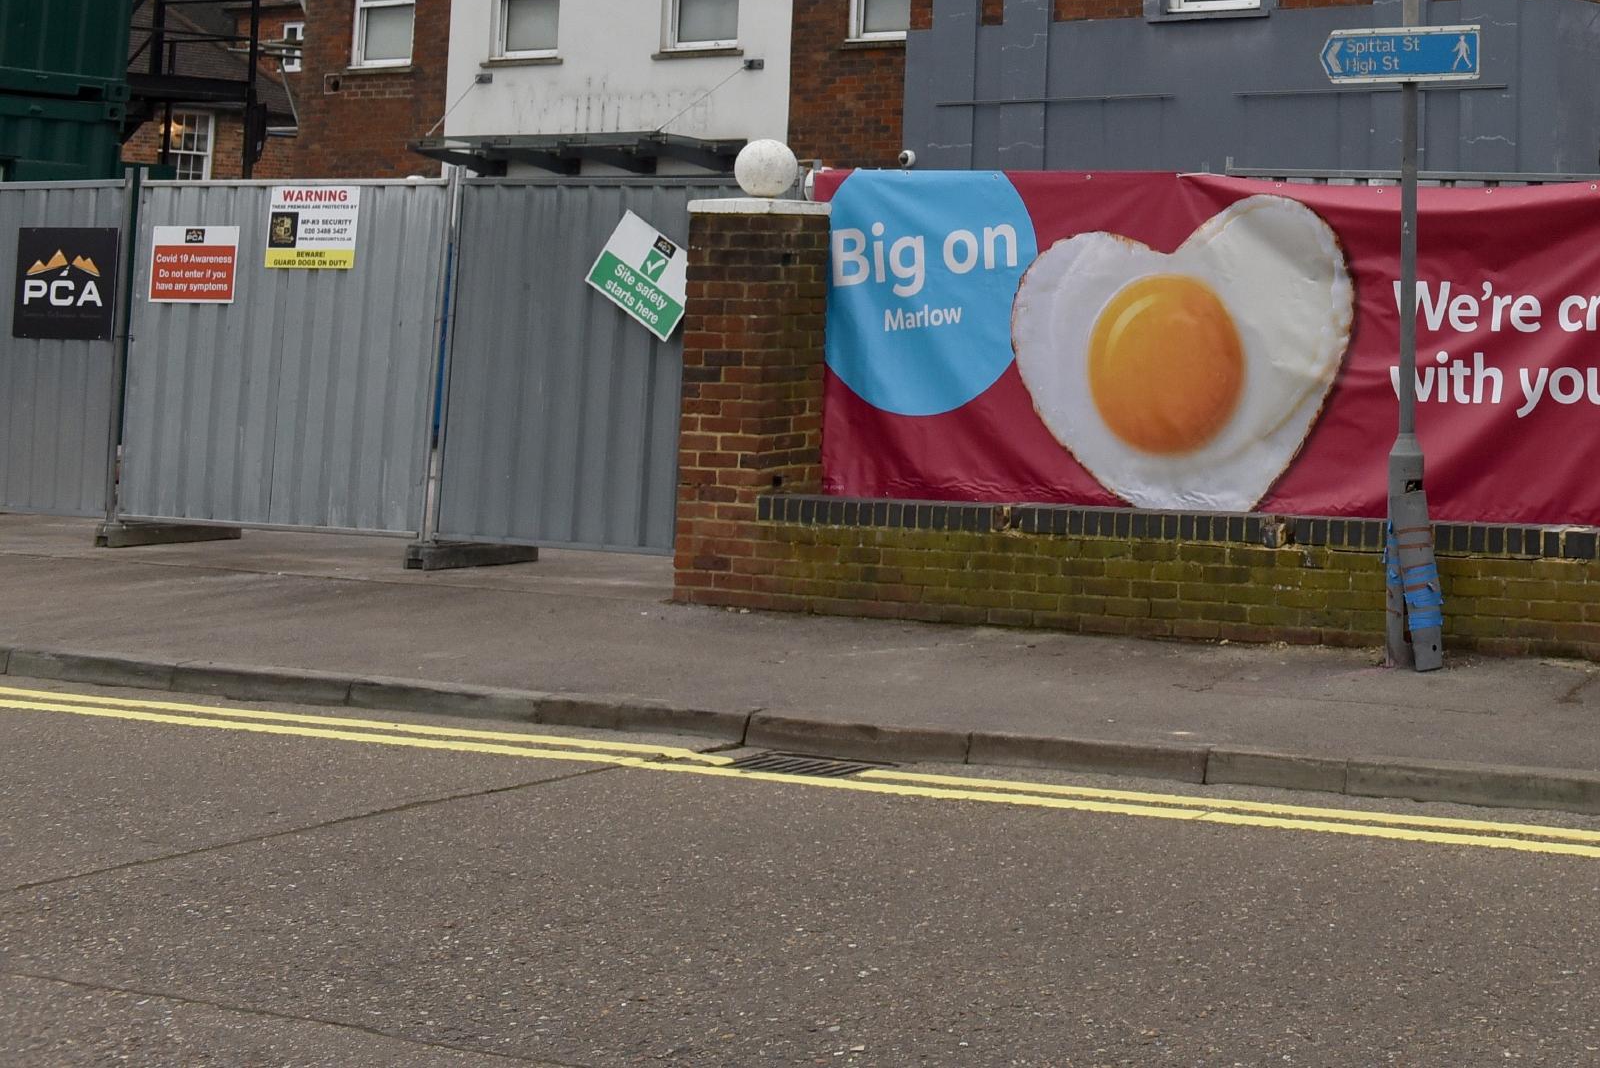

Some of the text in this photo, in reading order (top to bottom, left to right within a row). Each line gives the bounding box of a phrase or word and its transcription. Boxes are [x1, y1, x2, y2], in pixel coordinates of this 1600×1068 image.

[1346, 37, 1420, 55] Spittal St
[1346, 56, 1400, 74] High St
[283, 189, 348, 202] WARNING
[156, 254, 233, 264] Covid 19 Awareness
[832, 222, 1018, 298] Big on
[156, 282, 228, 292] have any symptoms
[159, 269, 226, 280] Do not enter if you
[614, 264, 668, 310] Site safety
[23, 279, 103, 307] PCA
[605, 280, 658, 324] starts here
[1392, 279, 1541, 333] We're
[884, 304, 962, 332] Marlow
[1389, 350, 1504, 404] with
